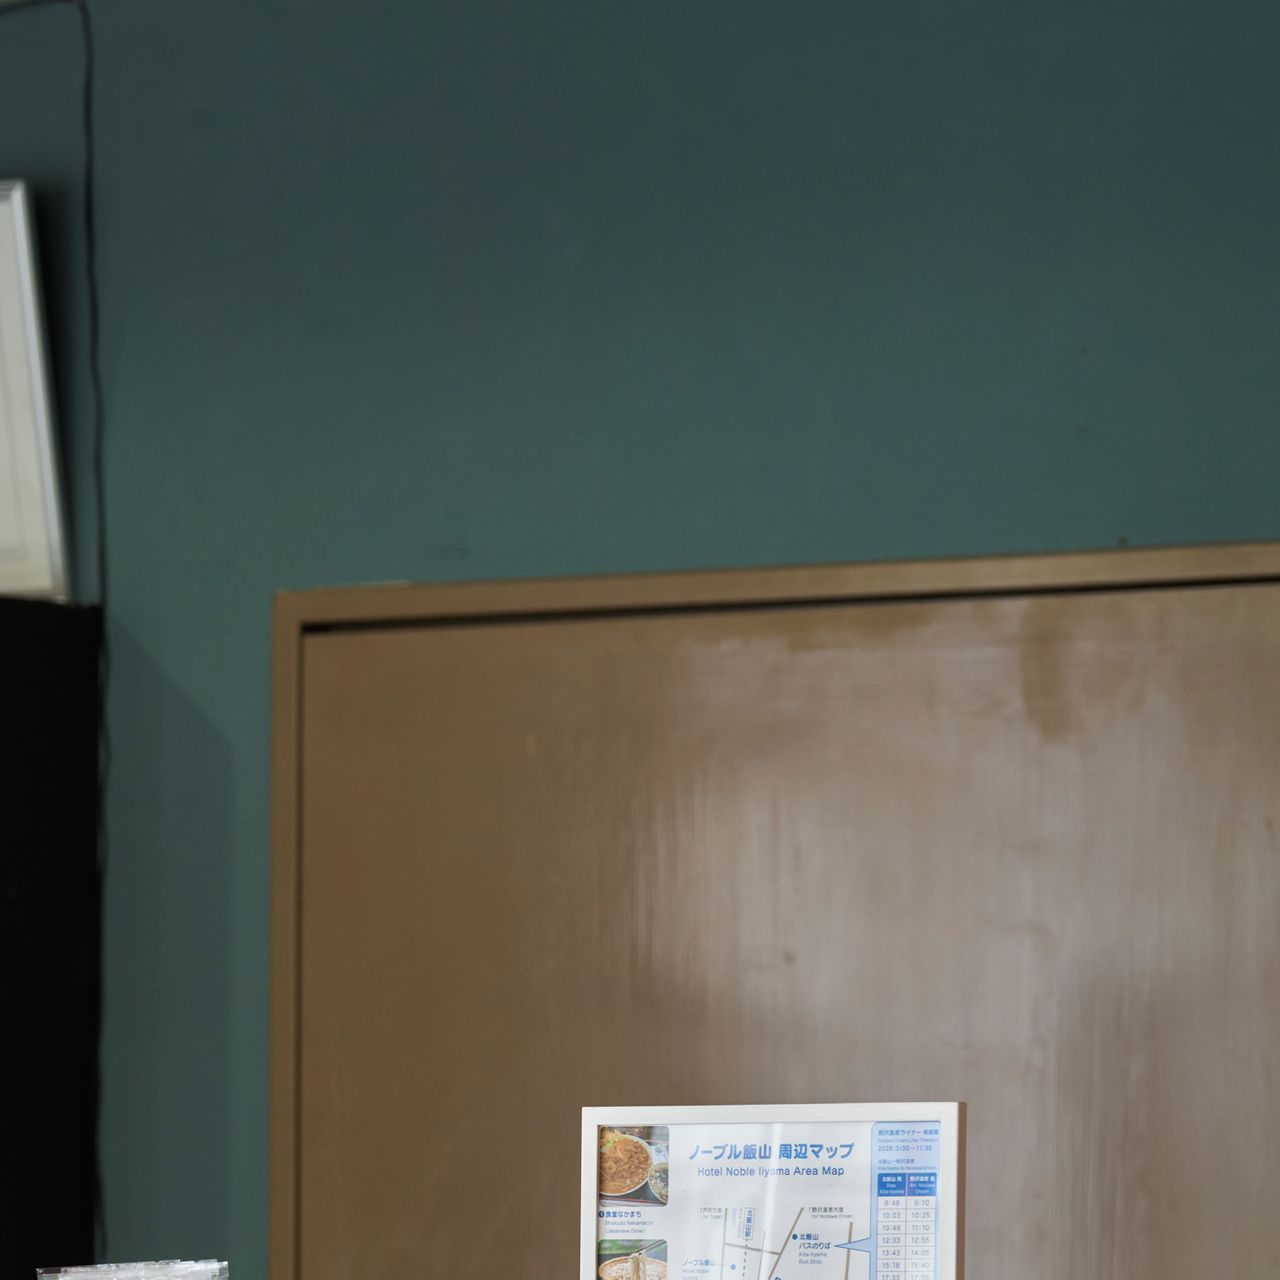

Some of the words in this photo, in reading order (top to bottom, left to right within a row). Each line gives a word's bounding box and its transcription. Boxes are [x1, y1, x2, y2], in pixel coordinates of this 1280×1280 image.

[690, 1144, 772, 1160] ノーブル飯山
[778, 1143, 855, 1159] 周辺マップ
[698, 1167, 723, 1176] Hotel
[726, 1167, 755, 1176] Noble
[793, 1167, 818, 1176] Area
[822, 1166, 845, 1178] Map
[799, 1242, 831, 1250] バスのりば
